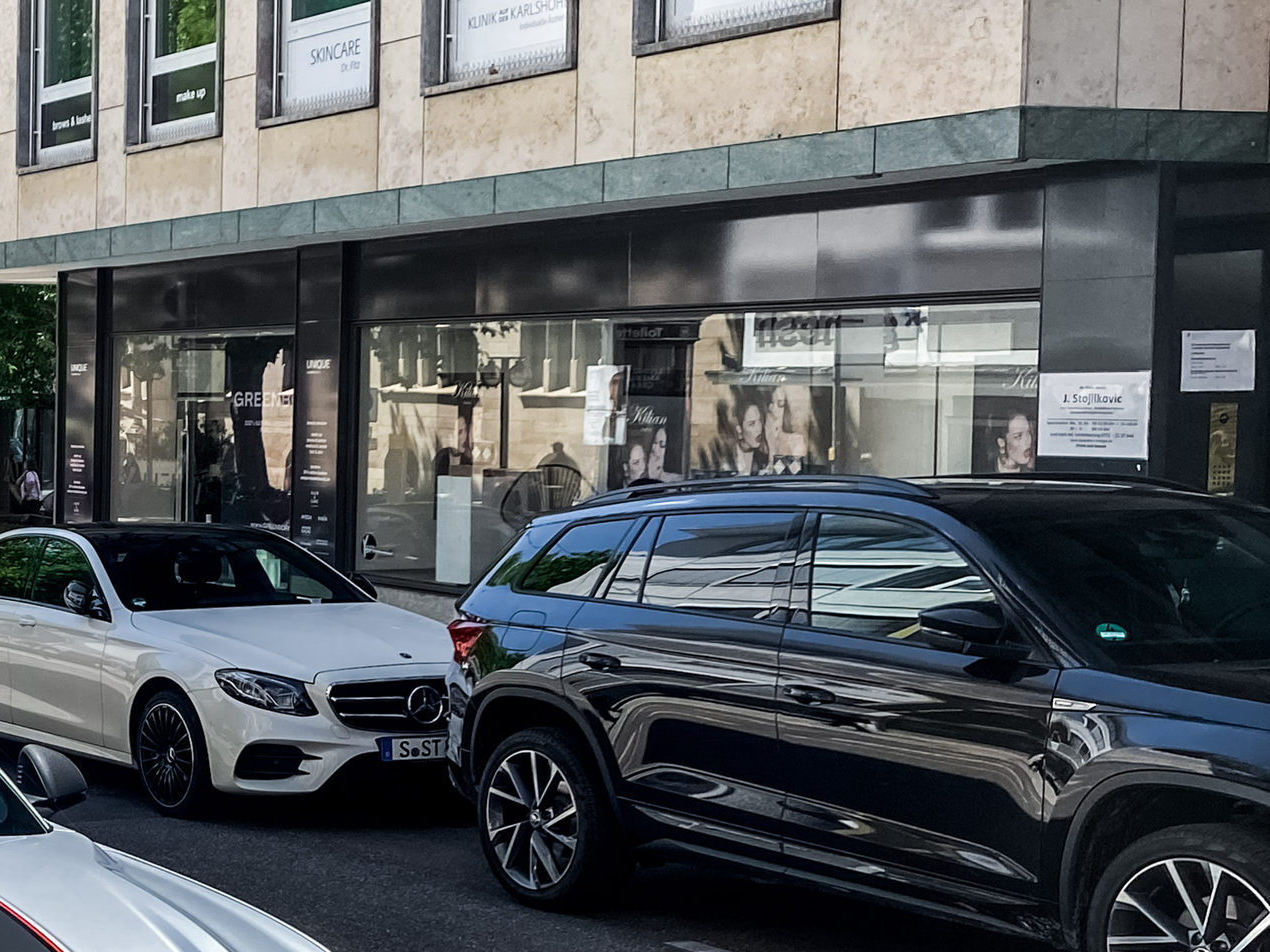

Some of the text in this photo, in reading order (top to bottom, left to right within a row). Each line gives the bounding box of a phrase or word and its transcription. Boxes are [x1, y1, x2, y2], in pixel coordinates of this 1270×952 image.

[468, 12, 498, 30] KLINIK
[310, 38, 361, 66] SKINCARE
[176, 87, 207, 103] make up
[76, 112, 92, 126] lashe
[306, 358, 332, 370] UNIQUE
[233, 391, 294, 408] GREENB
[1063, 393, 1071, 404] J.
[399, 739, 442, 758] S ST
